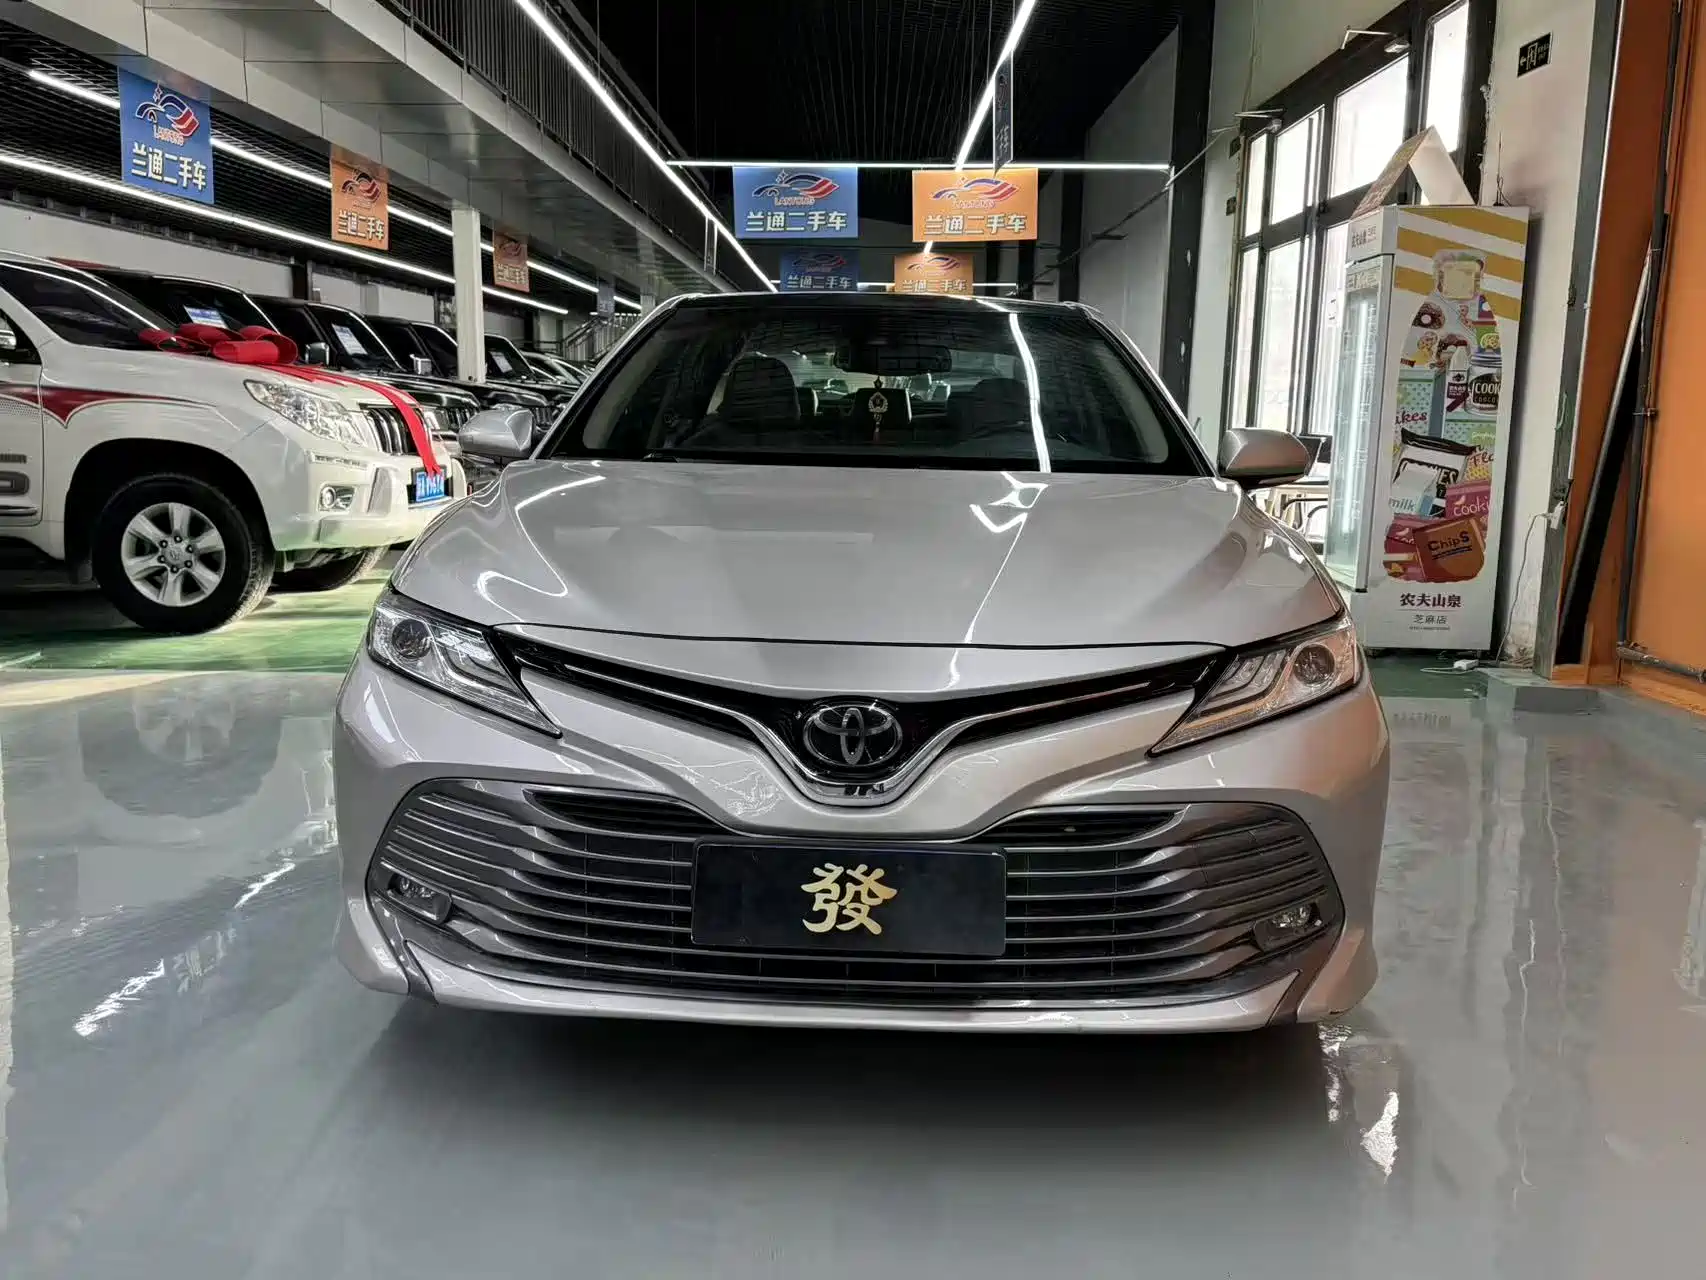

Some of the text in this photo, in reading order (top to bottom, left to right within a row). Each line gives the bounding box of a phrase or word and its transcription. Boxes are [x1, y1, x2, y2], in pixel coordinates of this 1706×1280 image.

[131, 142, 207, 190] 兰通二手车
[338, 209, 385, 240] 兰通二手车
[745, 211, 847, 232] 兰通二手车
[924, 213, 1027, 235] 兰通二手车
[787, 275, 852, 289] 兰通二手车
[902, 279, 967, 292] 兰通二手车
[1400, 592, 1462, 608] 农夫山泉
[1413, 614, 1447, 625] 芝麻店
[801, 863, 898, 935] 發
